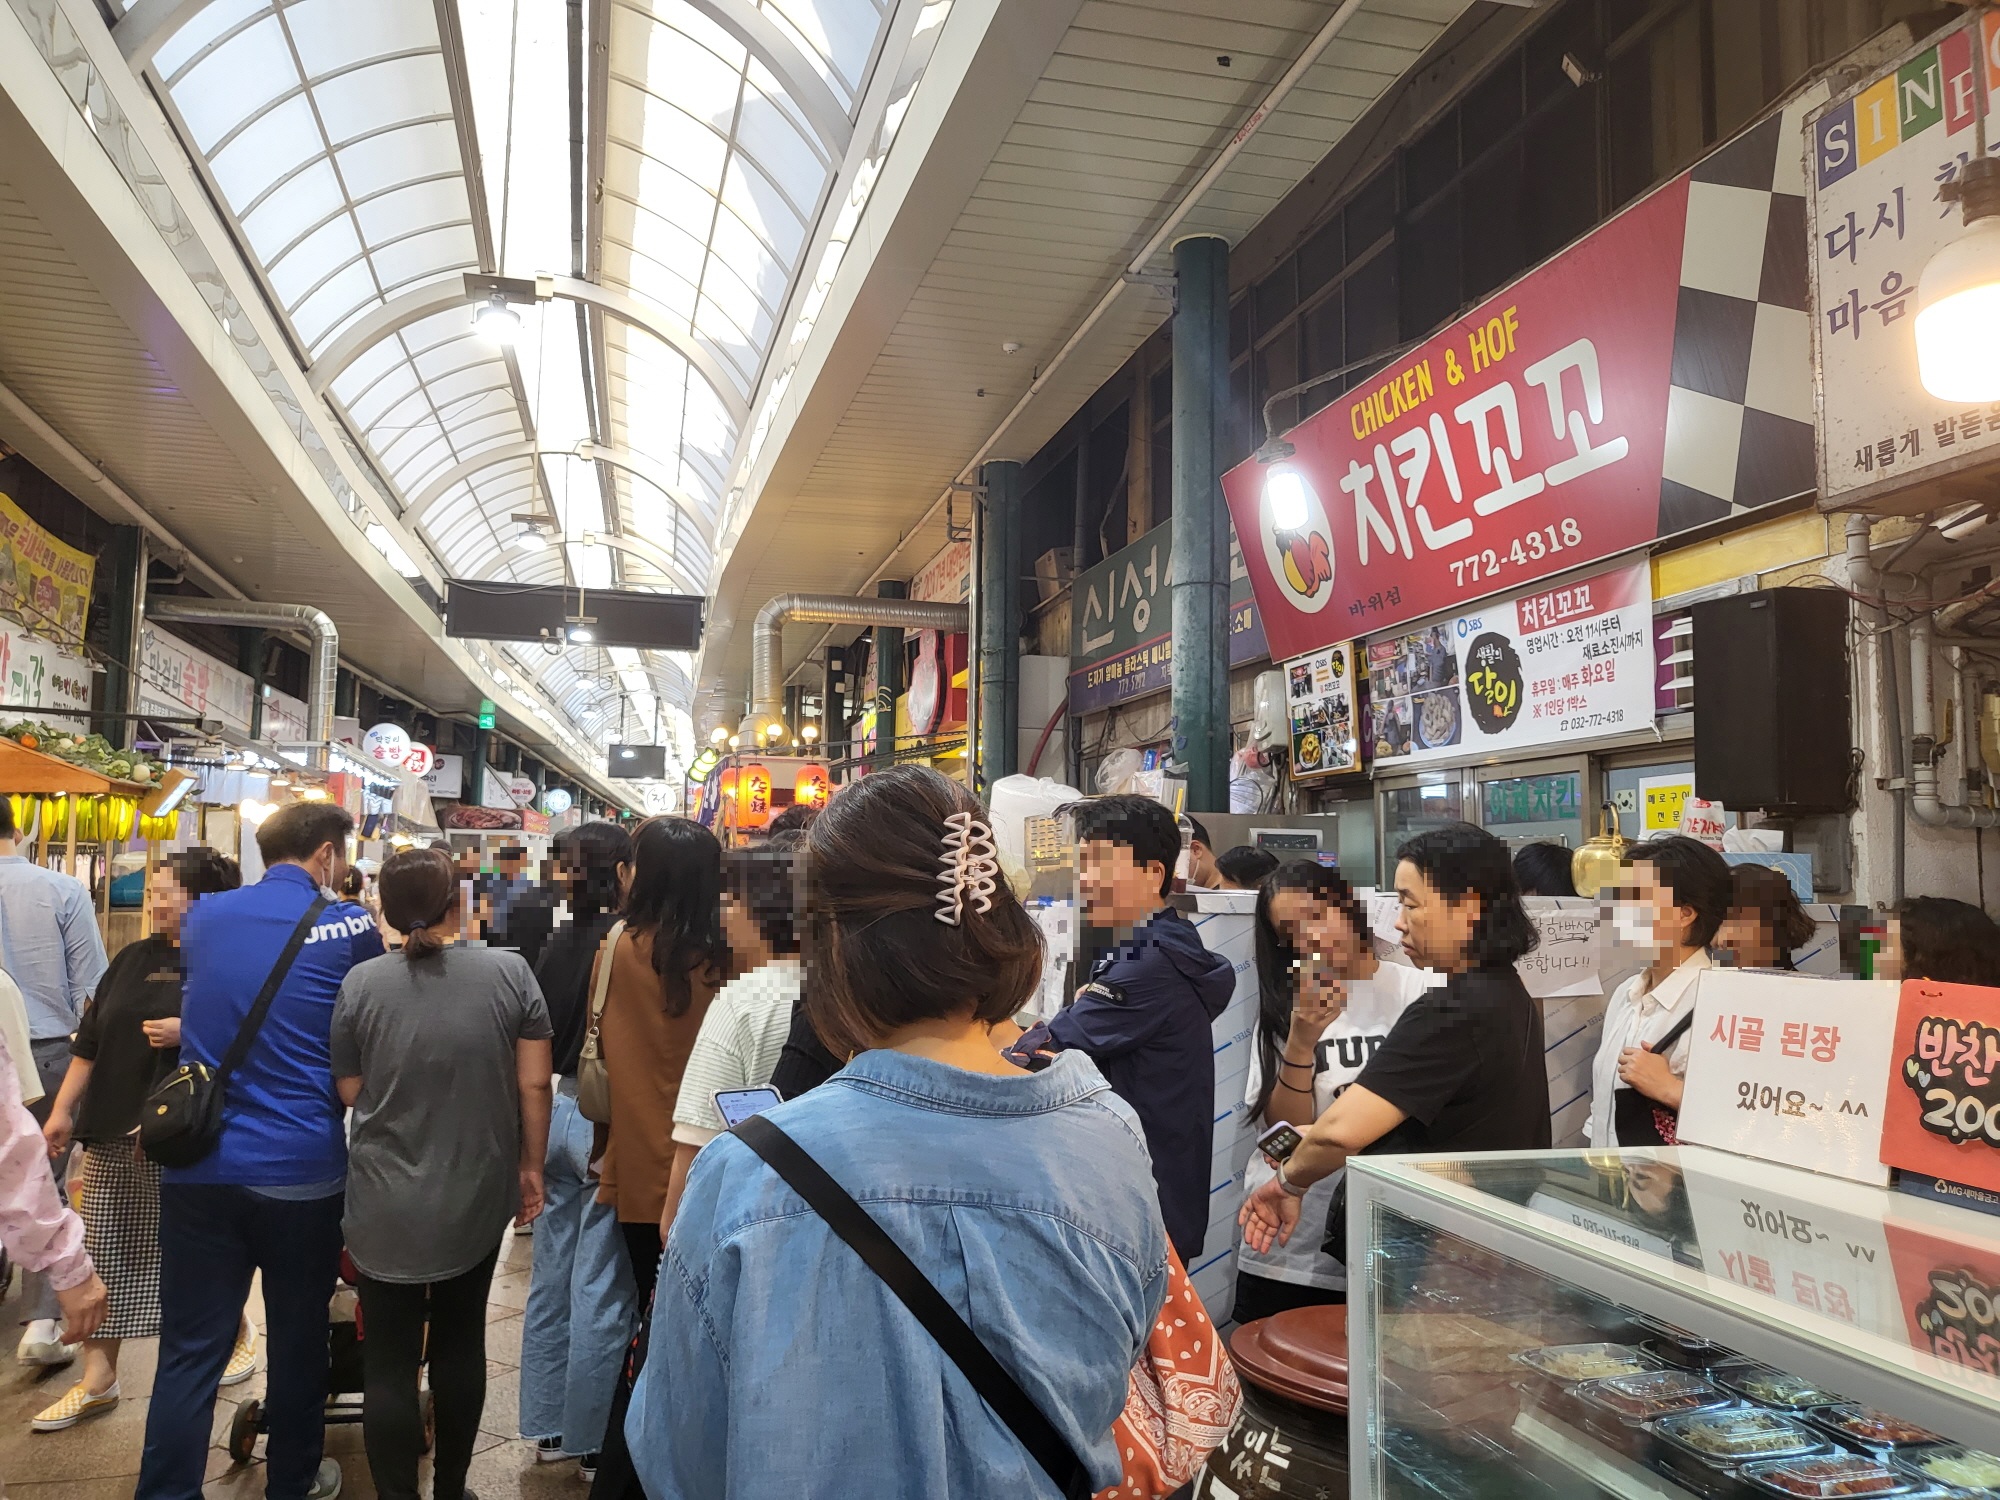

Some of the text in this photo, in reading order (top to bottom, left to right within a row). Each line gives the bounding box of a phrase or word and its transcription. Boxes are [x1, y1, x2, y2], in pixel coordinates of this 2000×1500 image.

[1824, 29, 2000, 173] SINP
[1823, 187, 1905, 263] 다시
[1827, 270, 1918, 341] 마음
[1351, 305, 1519, 441] CHICKEN & HOF
[1339, 338, 1629, 566] 치킨꼬꼬
[1854, 429, 1920, 473] 새롭게
[1450, 517, 1582, 587] 772-4318
[1082, 544, 1172, 657] 신성
[1349, 586, 1402, 617] 바위섬
[1521, 585, 1595, 630] 치킨꼬꼬
[1468, 617, 1483, 632] SBS
[1526, 631, 1559, 655] 영업시간
[1566, 626, 1584, 644] 오전
[1585, 614, 1622, 639] 11시부터
[1582, 629, 1643, 661] 재료소진시까지
[1476, 643, 1504, 666] 생활의
[1468, 666, 1517, 717] 달인
[1531, 677, 1556, 698] 휴무일
[1561, 672, 1580, 691] 매주
[1581, 658, 1616, 687] 화요일
[1544, 698, 1565, 717] 1인당
[1567, 695, 1588, 713] 1박스
[1571, 709, 1624, 730] 032-772-4318
[1490, 777, 1576, 822] 야채치킨
[1709, 1014, 1842, 1063] 시골 된장
